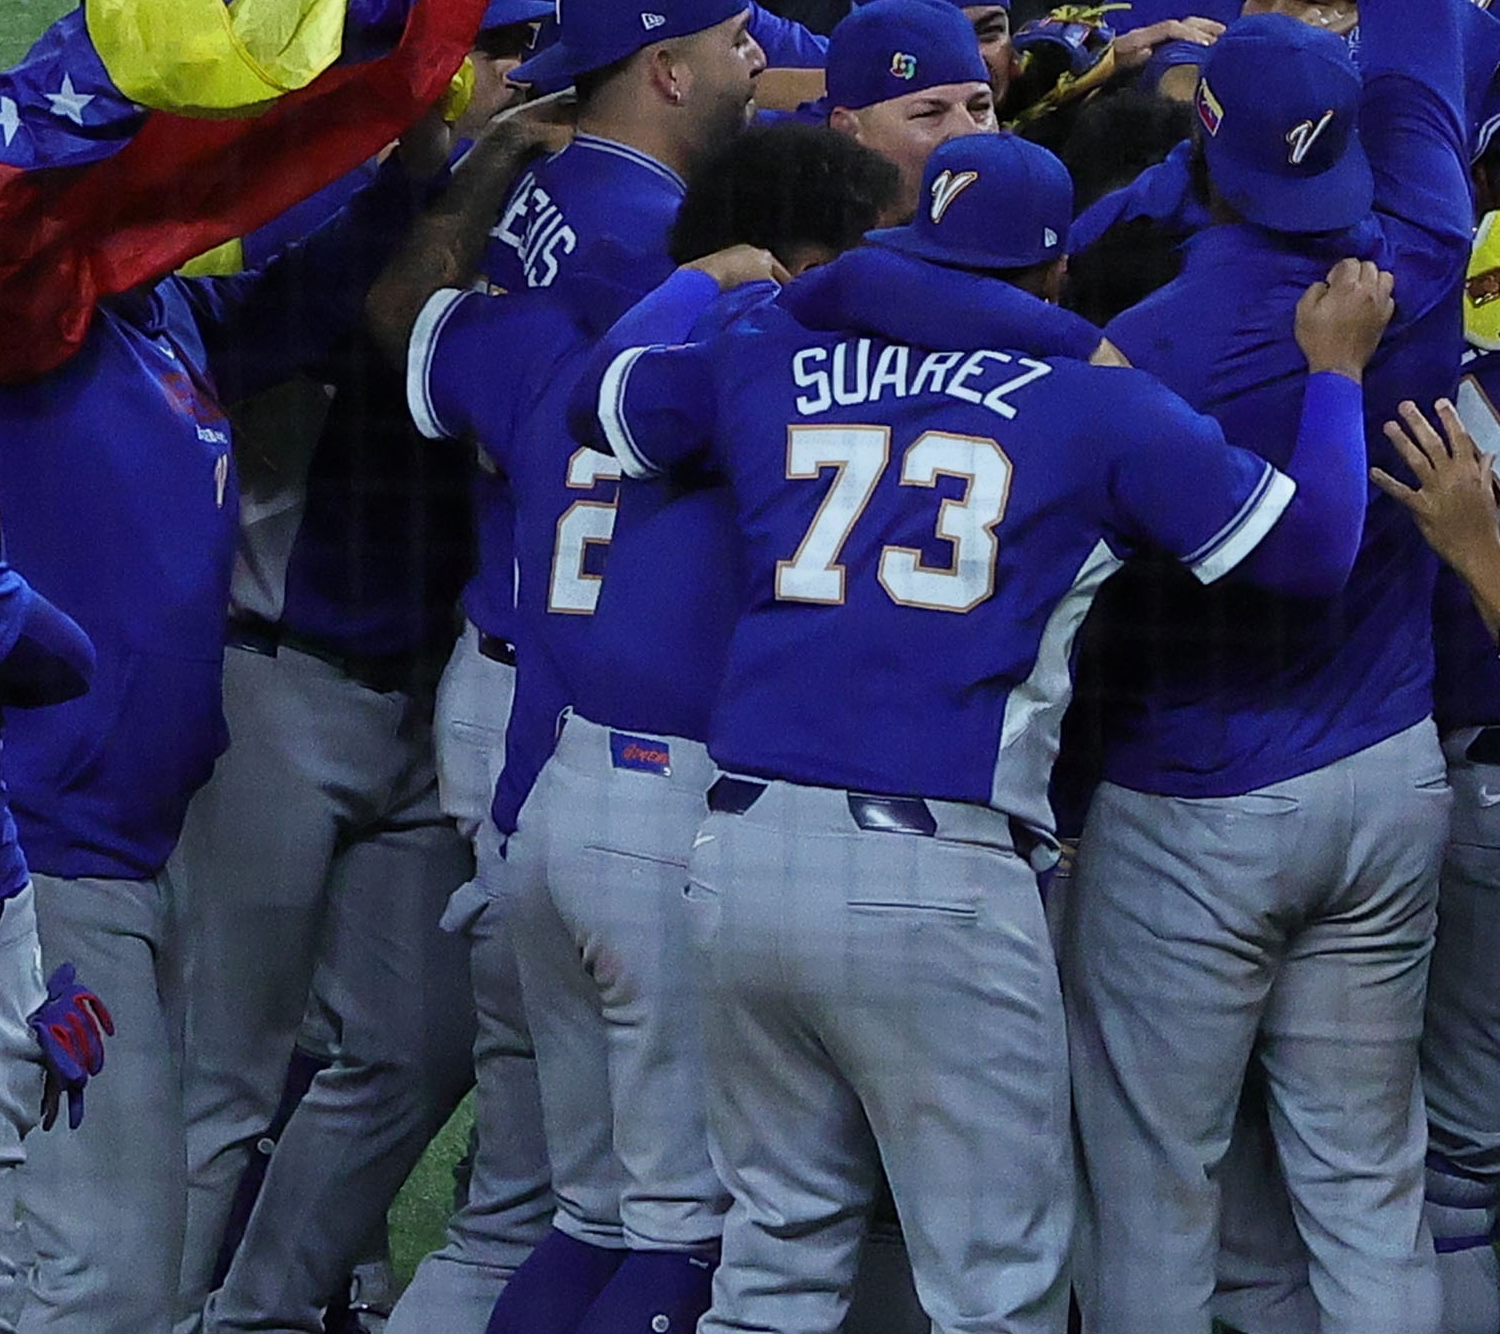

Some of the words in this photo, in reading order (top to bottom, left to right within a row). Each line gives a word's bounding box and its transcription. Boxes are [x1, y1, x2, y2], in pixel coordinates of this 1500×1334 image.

[1285, 109, 1335, 166] V
[930, 170, 978, 223] V
[792, 338, 1053, 420] SUAREZ
[774, 423, 1013, 614] 73
